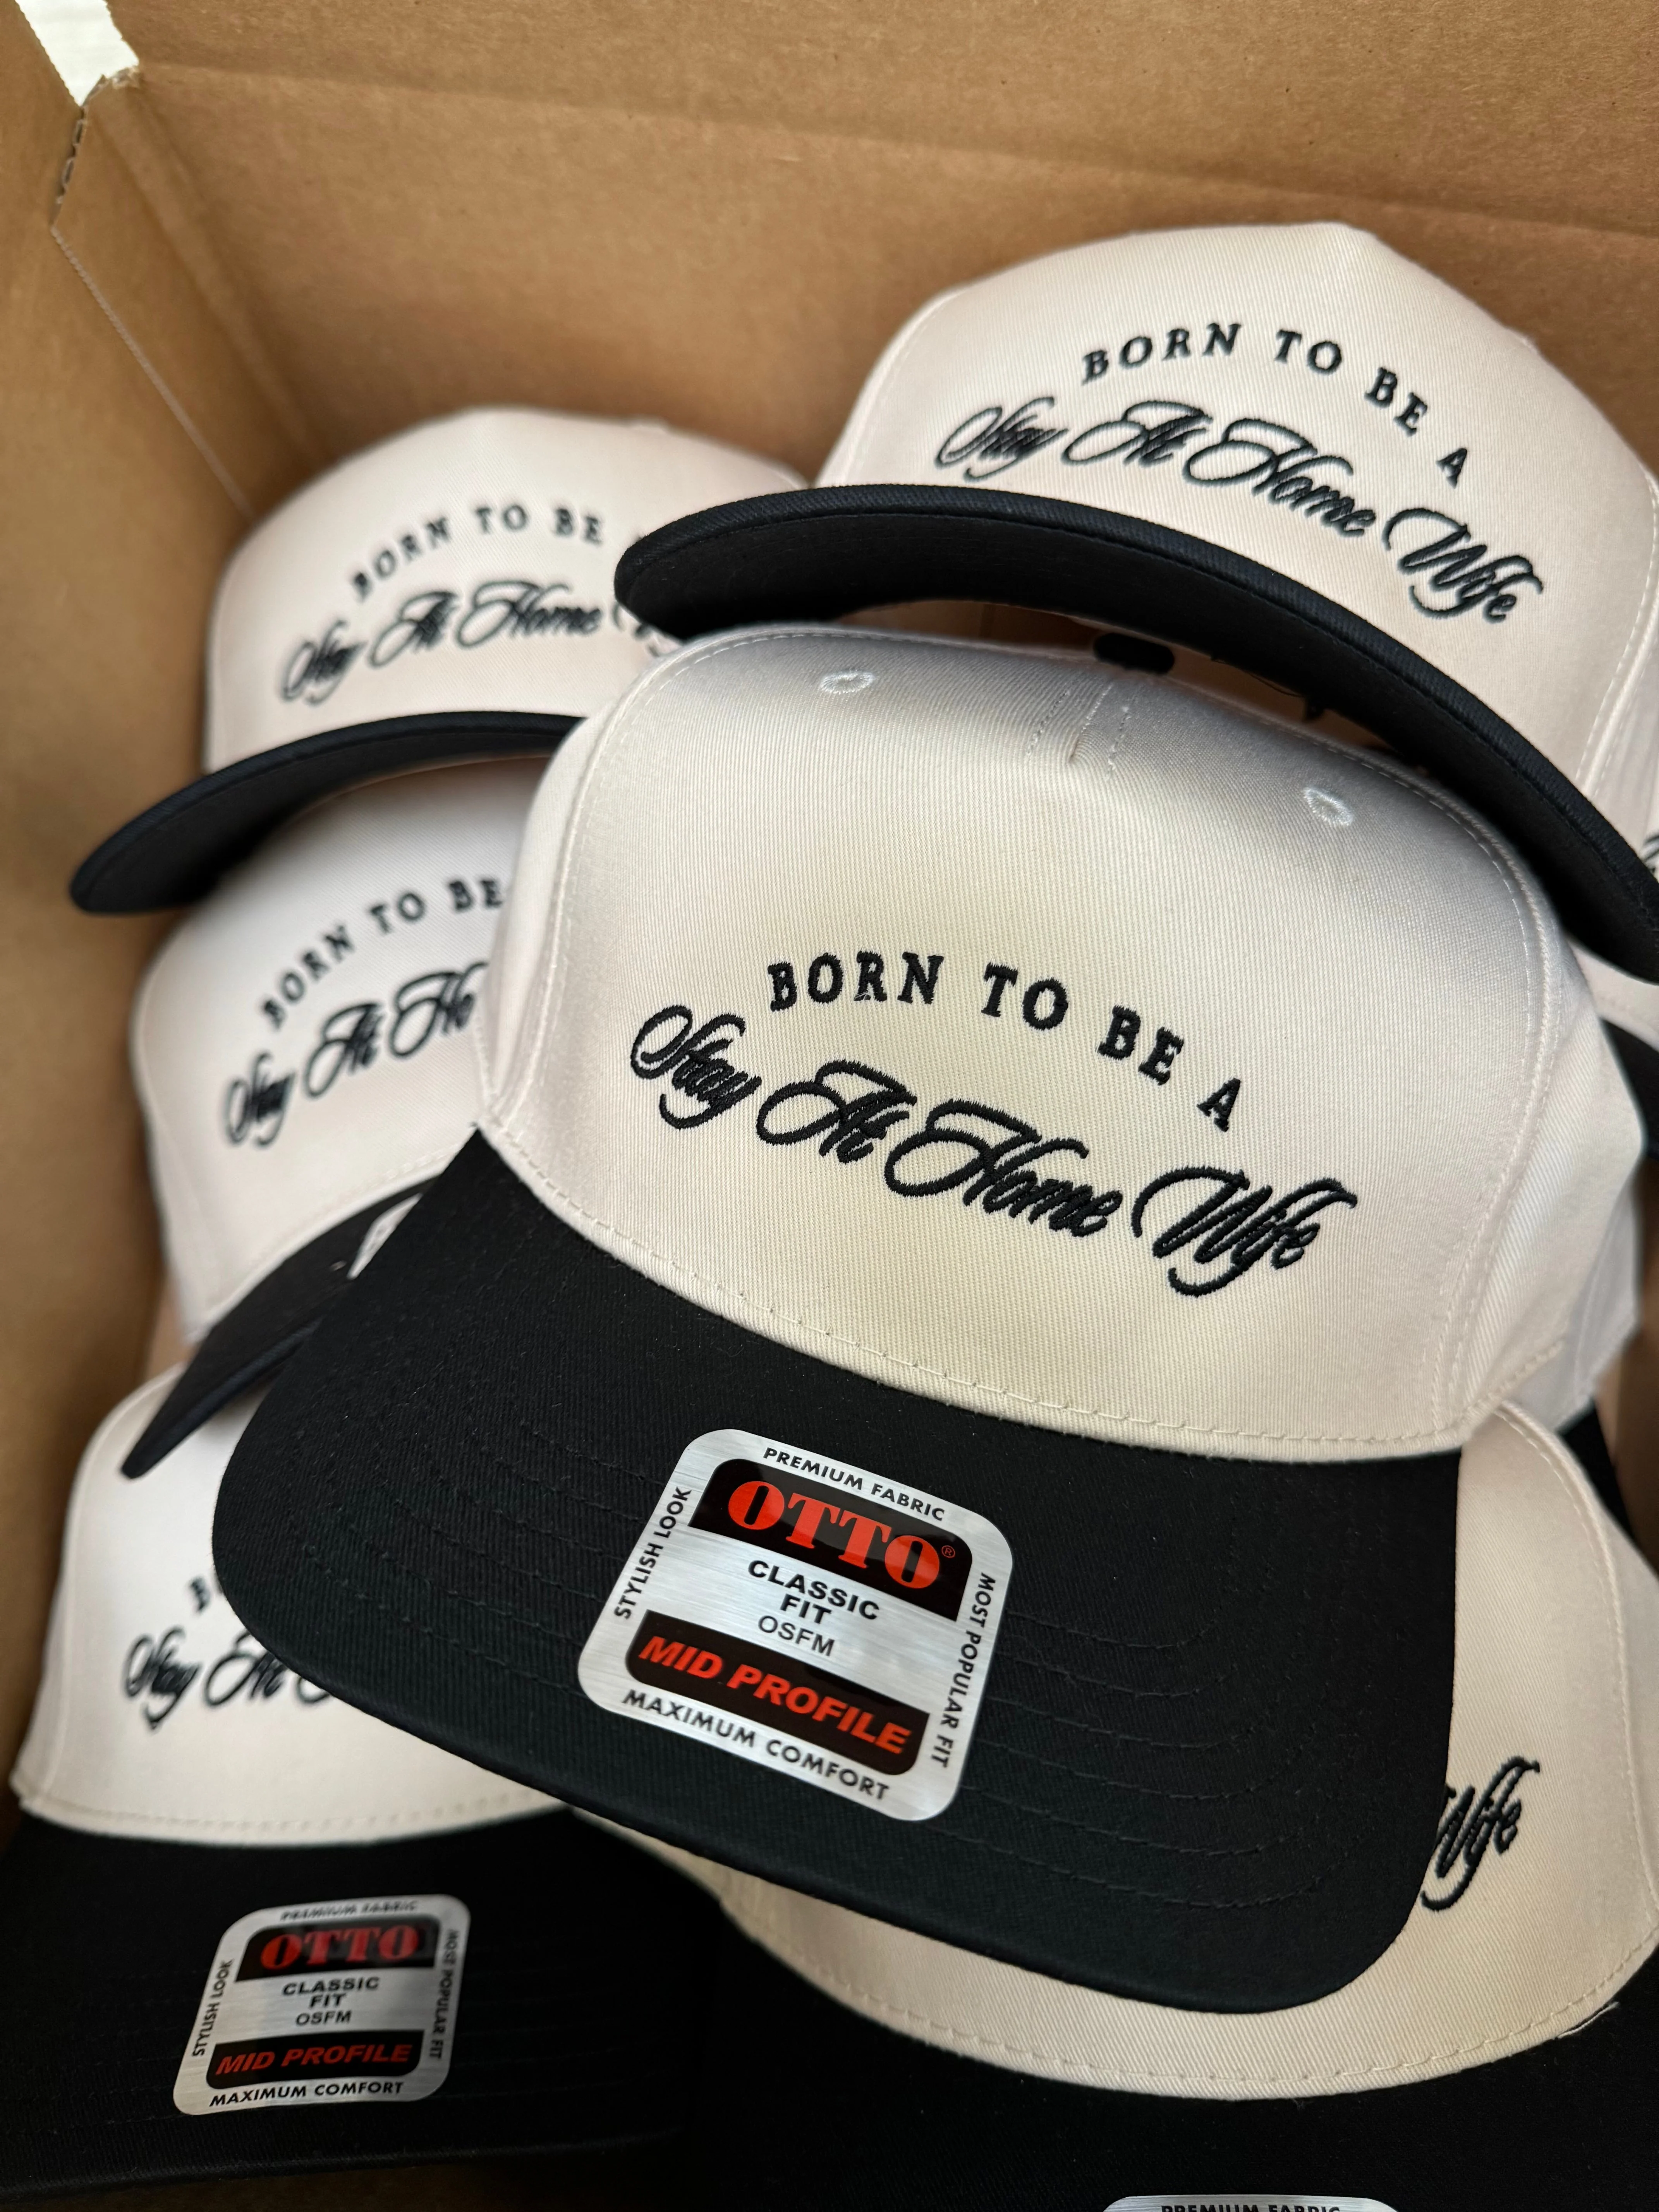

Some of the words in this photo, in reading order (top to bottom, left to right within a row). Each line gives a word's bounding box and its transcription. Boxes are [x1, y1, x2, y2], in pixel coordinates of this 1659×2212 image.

[1081, 322, 1241, 385] BORN
[1274, 329, 1343, 374] TO
[1365, 368, 1428, 436] BE
[1437, 447, 1468, 488] A
[935, 396, 1068, 481] Stay
[1061, 400, 1212, 466] At
[1183, 418, 1377, 538] Home
[1382, 507, 1544, 624] Wife
[352, 517, 451, 600] BORN
[475, 504, 529, 534] TO
[553, 507, 603, 544] BE
[368, 891, 426, 934] TO
[447, 878, 503, 912] BE
[768, 951, 944, 1011] BORN
[982, 963, 1068, 1030] TO
[1097, 1006, 1185, 1084] BE
[1197, 1077, 1242, 1132] A
[630, 1005, 762, 1129] Stay
[755, 1060, 917, 1163] At
[884, 1099, 1124, 1238] Home
[1132, 1164, 1357, 1297] Wife
[763, 1447, 864, 1490] PREMIUM
[871, 1484, 945, 1520] FABRIC
[614, 1542, 663, 1619] STYLISH
[654, 1487, 691, 1539] LOOK
[748, 1559, 880, 1620] CLASSIC
[780, 1594, 832, 1624] FIT
[963, 1572, 996, 1628] MOST
[757, 1614, 835, 1657] OSFM
[639, 1636, 723, 1679] MID
[727, 1664, 911, 1755] PROFILE
[945, 1630, 982, 1728] POPULAR
[622, 1689, 756, 1747] MAXIMUM
[766, 1738, 889, 1801] COMFORT
[931, 1734, 954, 1767] FIT
[280, 1903, 357, 1921] PREMIUM
[362, 1900, 419, 1913] FABRIC
[446, 1929, 459, 1968] MOST
[192, 2000, 217, 2057] STYLISH
[213, 1960, 234, 1997] LOOK
[282, 1977, 379, 1995] CLASSIC
[309, 1994, 346, 2009] FIT
[433, 1970, 454, 2034] POPULAR
[295, 2011, 352, 2026] OSFM
[215, 2051, 275, 2075] MID
[281, 2044, 412, 2068] PROFILE
[429, 2040, 444, 2059] FIT
[209, 2085, 306, 2107] MAXIMUM
[314, 2081, 404, 2095] COMFORT
